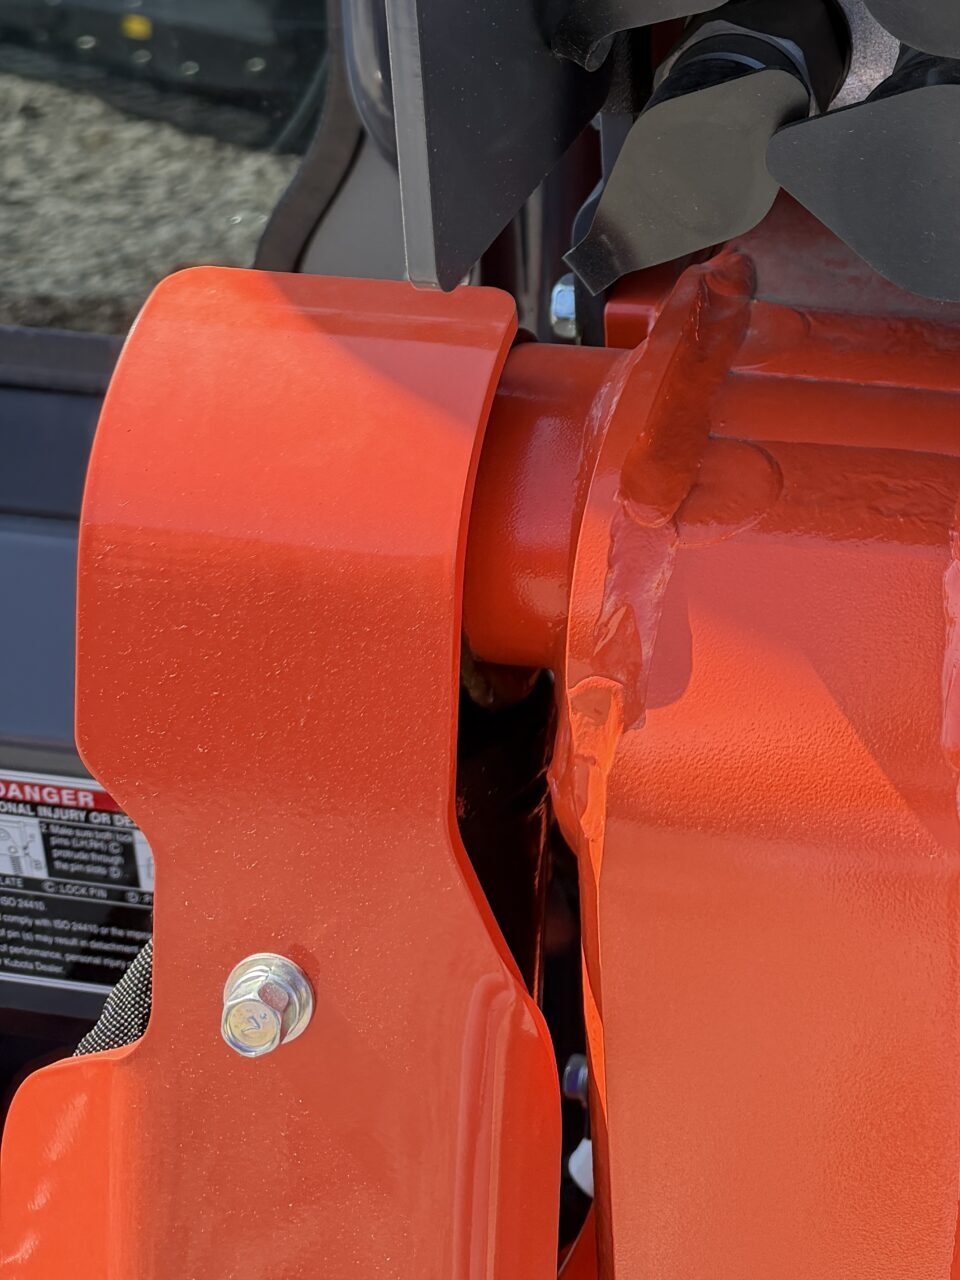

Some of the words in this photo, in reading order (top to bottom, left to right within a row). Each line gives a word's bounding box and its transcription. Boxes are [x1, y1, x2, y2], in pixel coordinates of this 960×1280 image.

[37, 806, 87, 823] INJURY
[90, 811, 111, 826] OR
[2, 914, 33, 928] comply
[4, 958, 33, 970] Kubota
